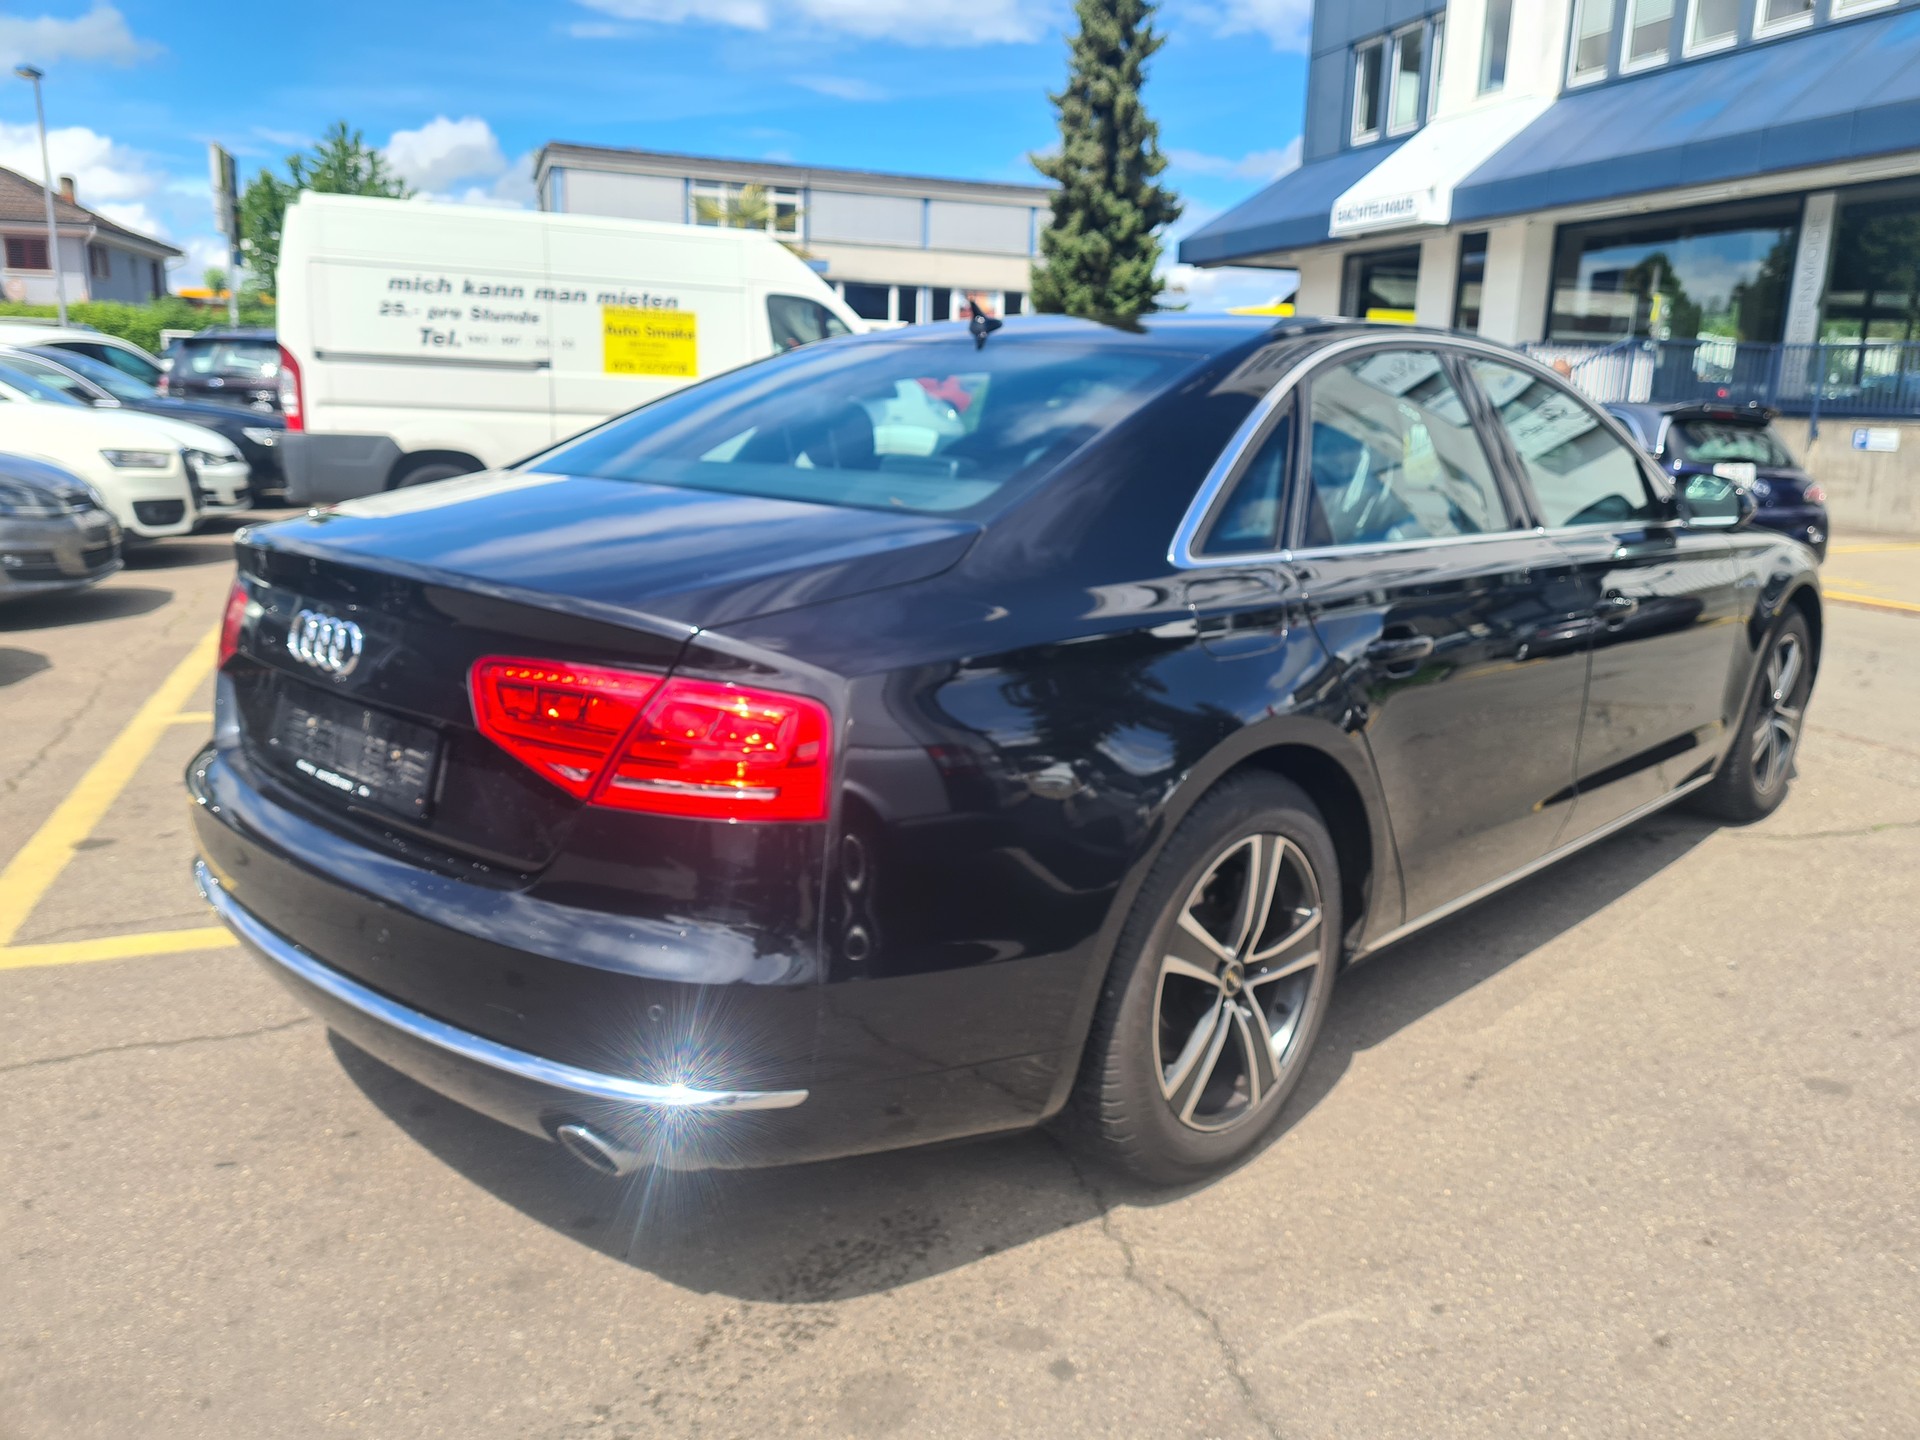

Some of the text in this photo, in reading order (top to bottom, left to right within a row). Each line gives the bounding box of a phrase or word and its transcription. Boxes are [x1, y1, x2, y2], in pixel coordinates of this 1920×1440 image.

[388, 276, 679, 309] mich kann man mieten
[427, 306, 462, 321] pro
[470, 306, 541, 324] Stunde
[420, 327, 462, 347] Tel.
